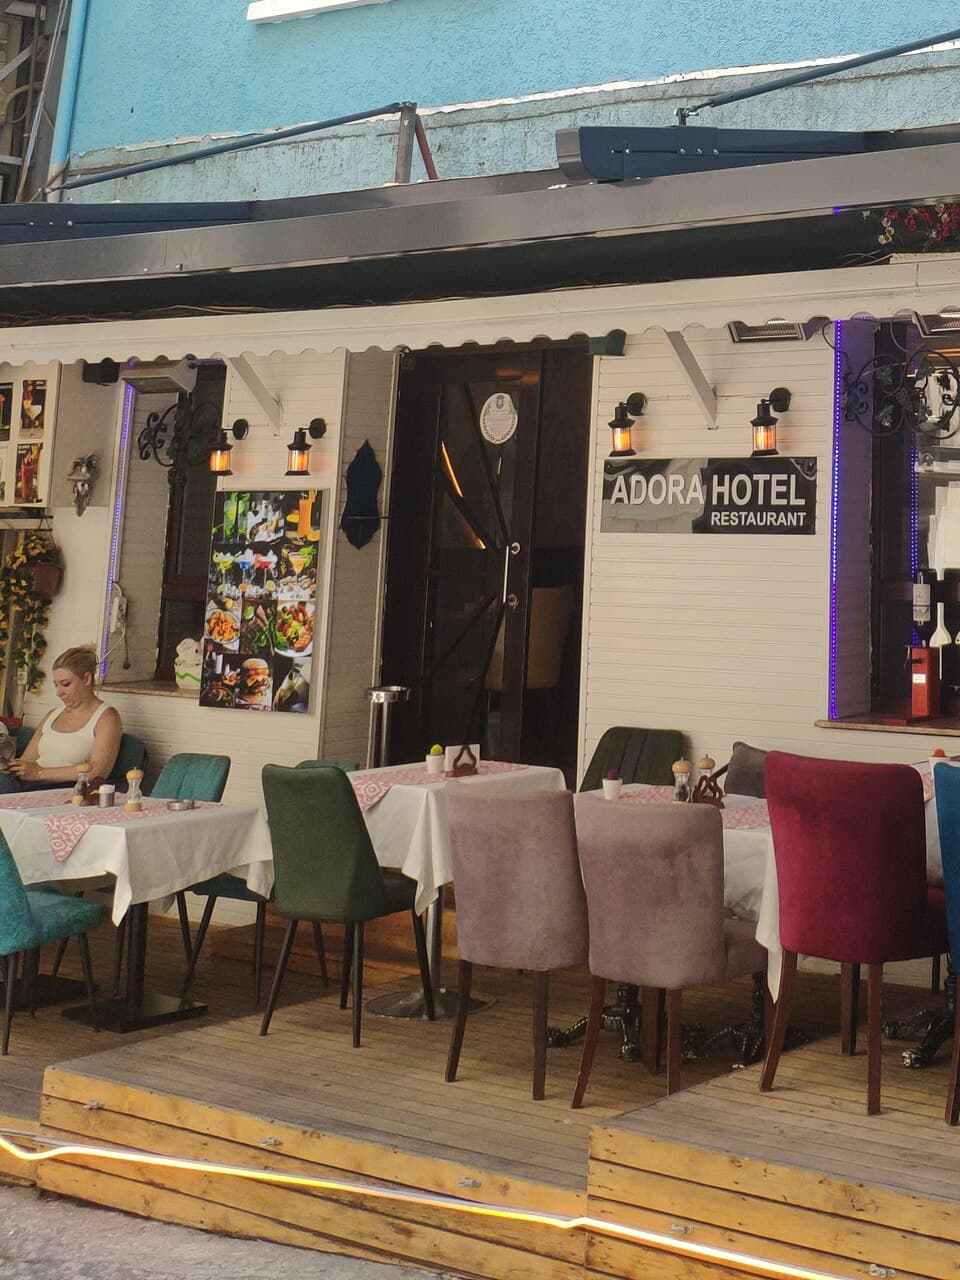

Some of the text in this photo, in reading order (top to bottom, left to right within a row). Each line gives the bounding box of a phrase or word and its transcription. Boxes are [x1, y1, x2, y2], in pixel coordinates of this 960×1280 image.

[610, 474, 806, 506] ADORA HOTEL
[710, 511, 807, 527] RESTAURANT
